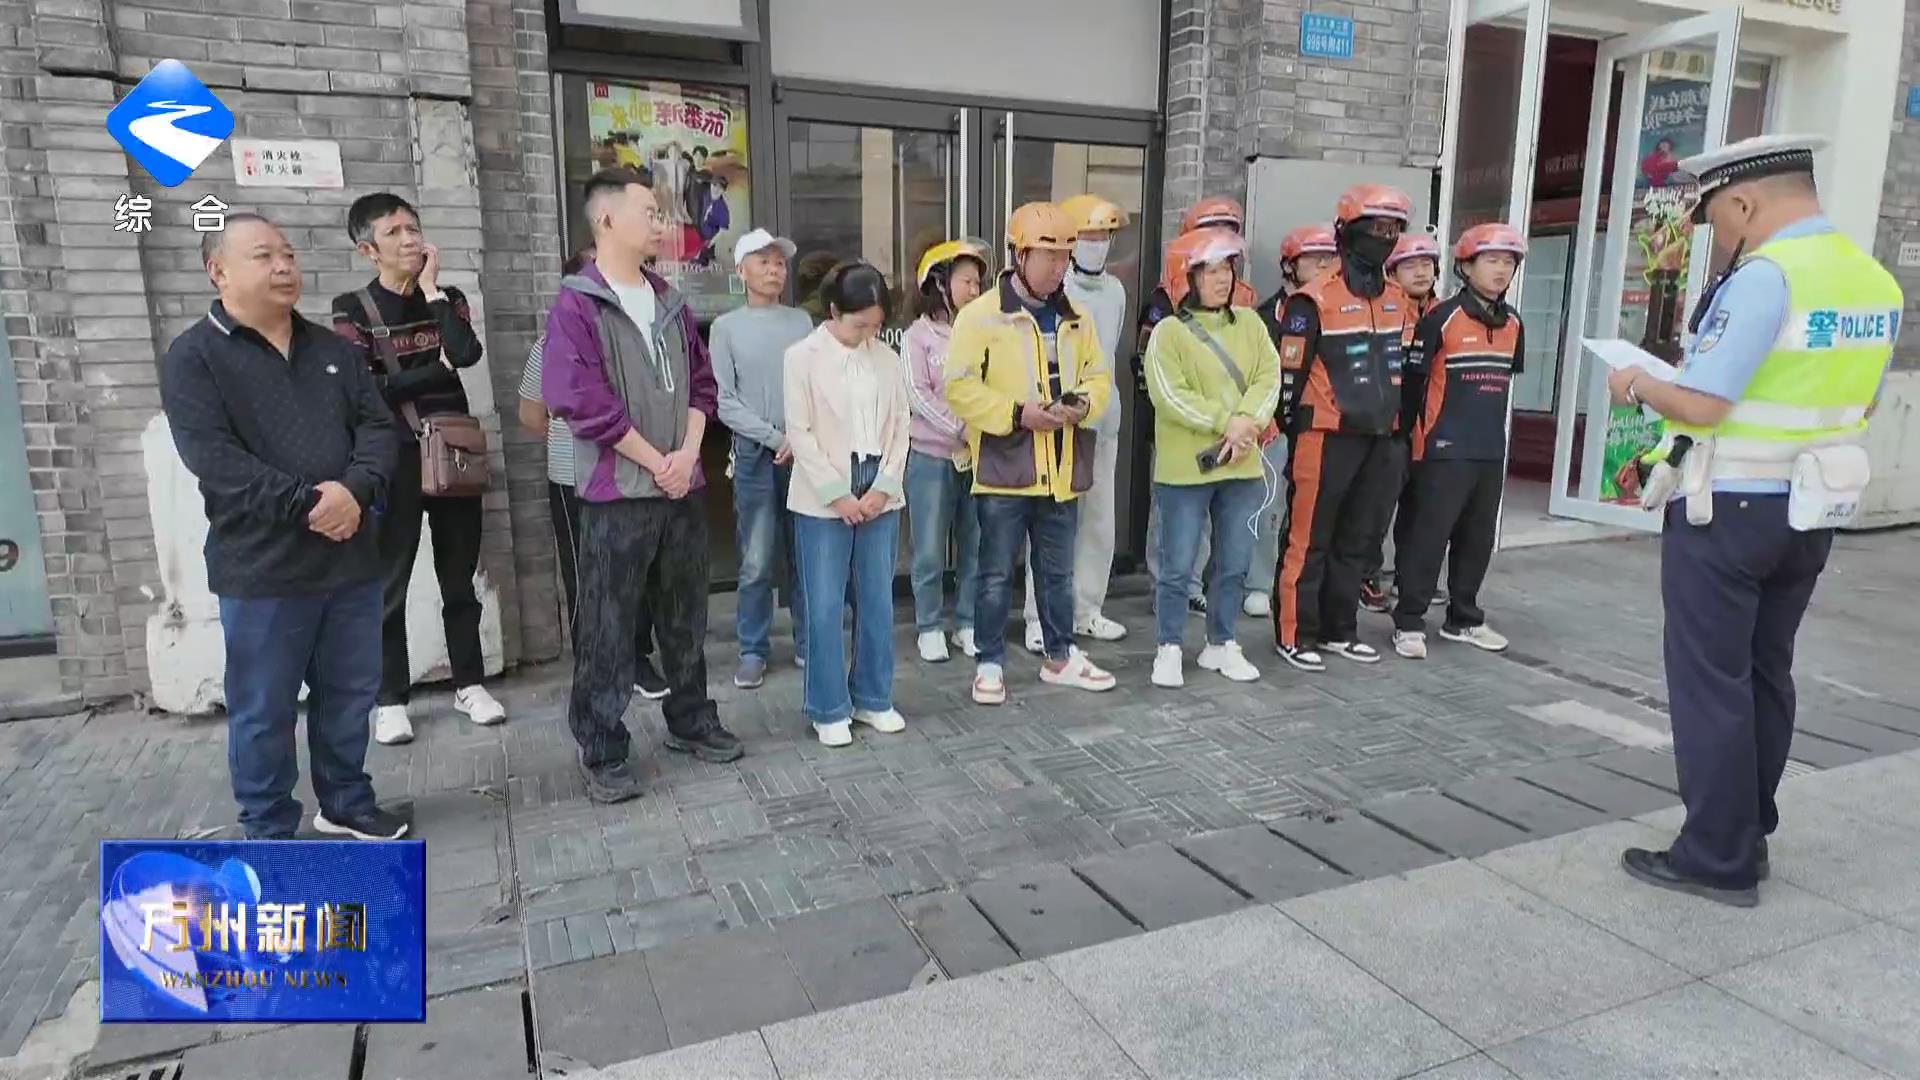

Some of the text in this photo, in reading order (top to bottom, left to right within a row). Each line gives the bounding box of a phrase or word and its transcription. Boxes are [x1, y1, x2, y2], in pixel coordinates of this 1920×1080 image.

[262, 149, 302, 161] 消火栓
[264, 164, 303, 176] 灭火器
[1806, 310, 1838, 348] 警
[1841, 314, 1885, 338] POLICE
